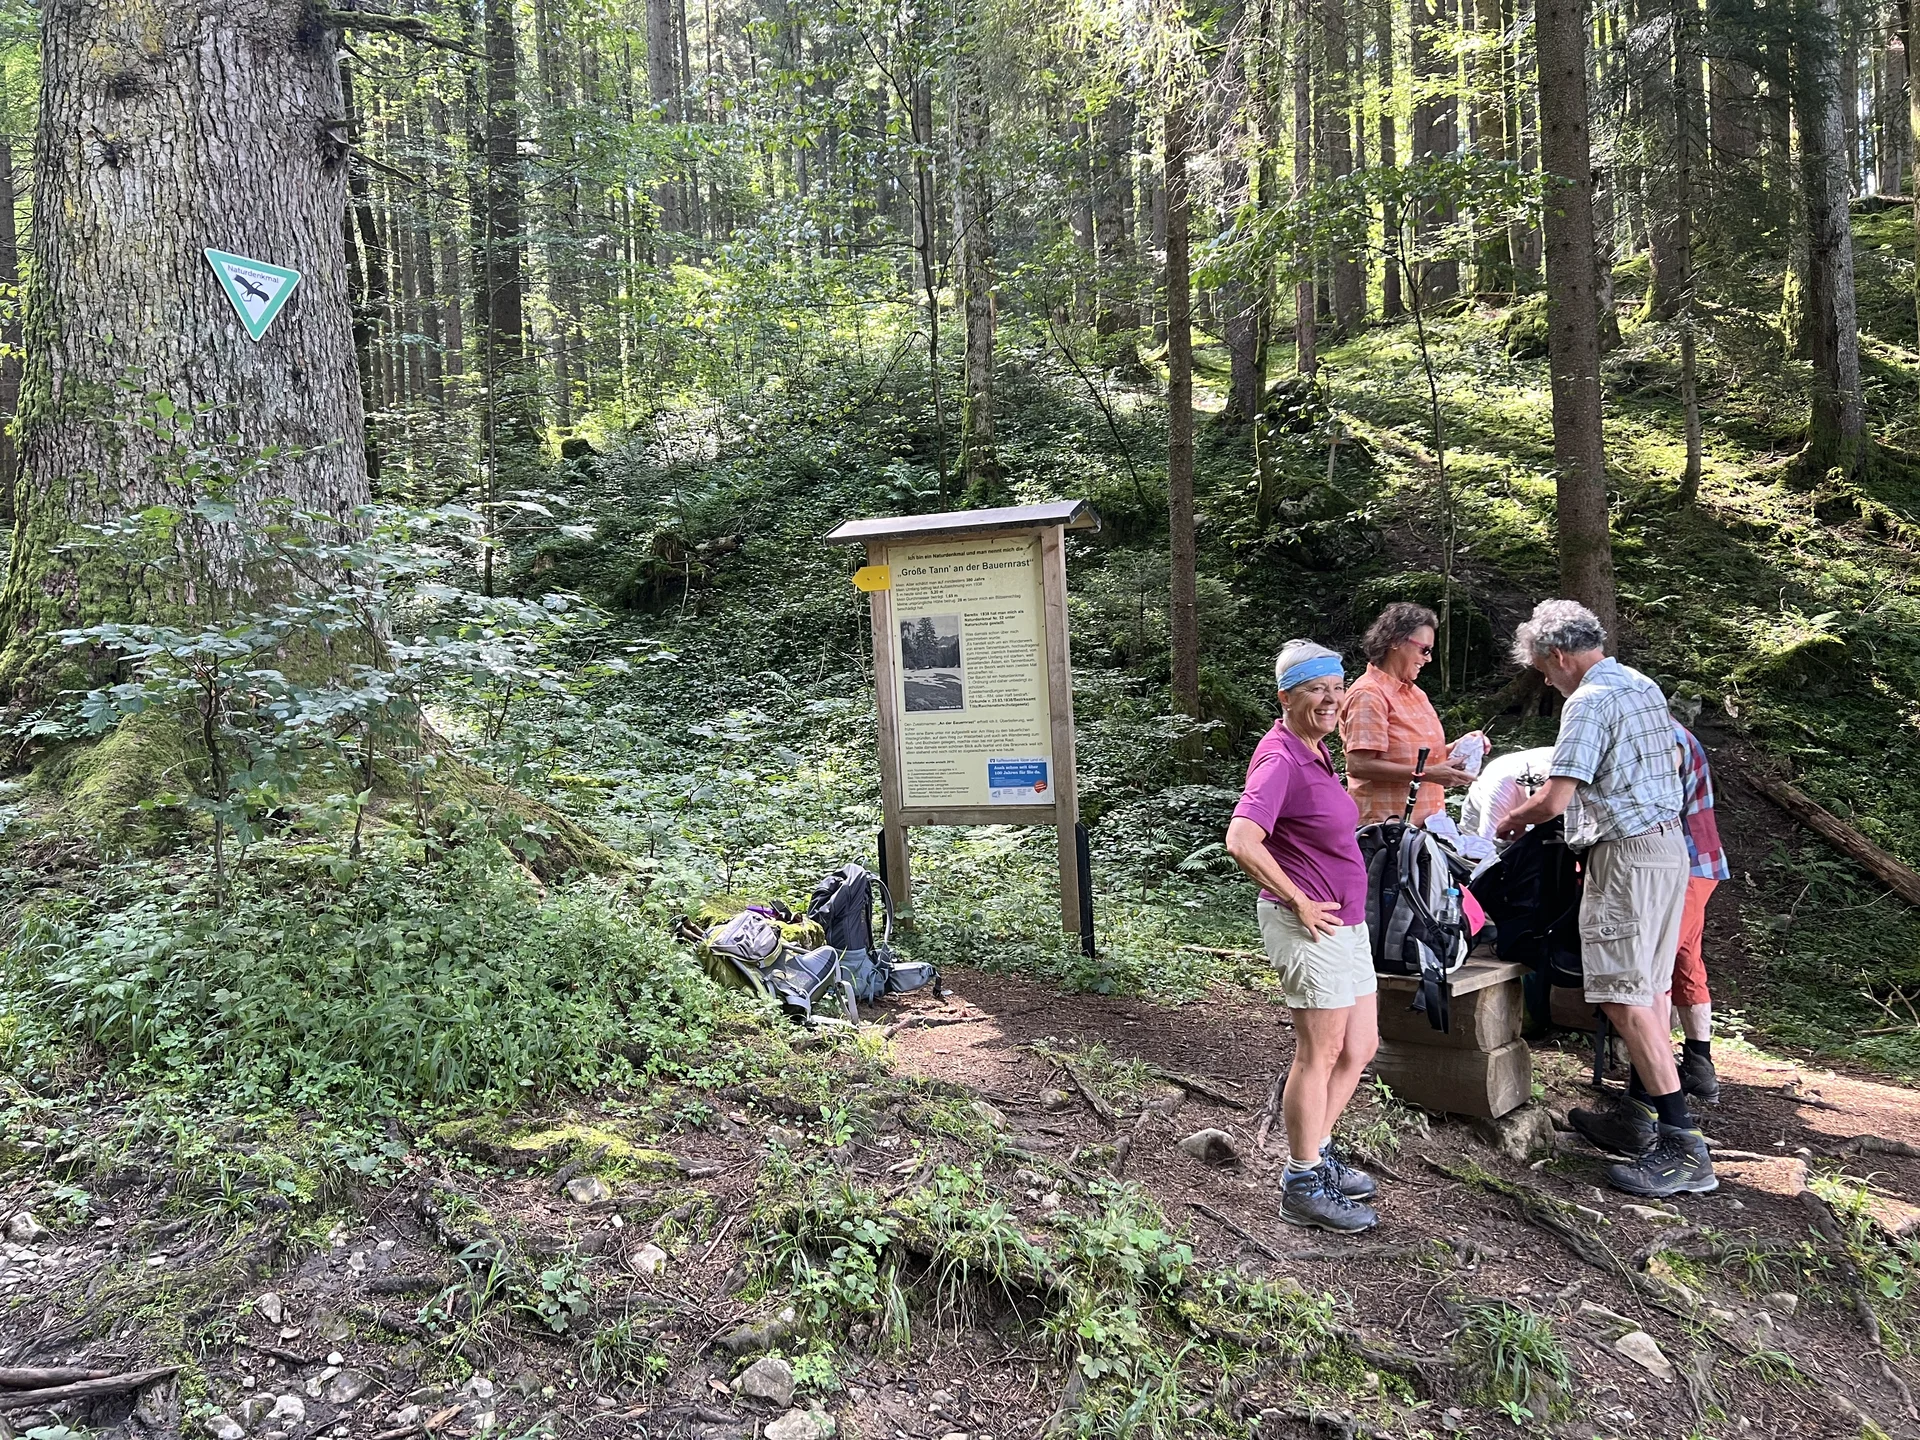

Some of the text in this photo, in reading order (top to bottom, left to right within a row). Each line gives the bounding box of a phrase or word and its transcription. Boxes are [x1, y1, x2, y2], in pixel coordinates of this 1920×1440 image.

[227, 264, 279, 284] Naturdenkmal
[897, 567, 927, 578] „Große
[929, 565, 951, 574] Tann'
[966, 563, 980, 571] der
[982, 559, 1034, 570] Bauernrast“
